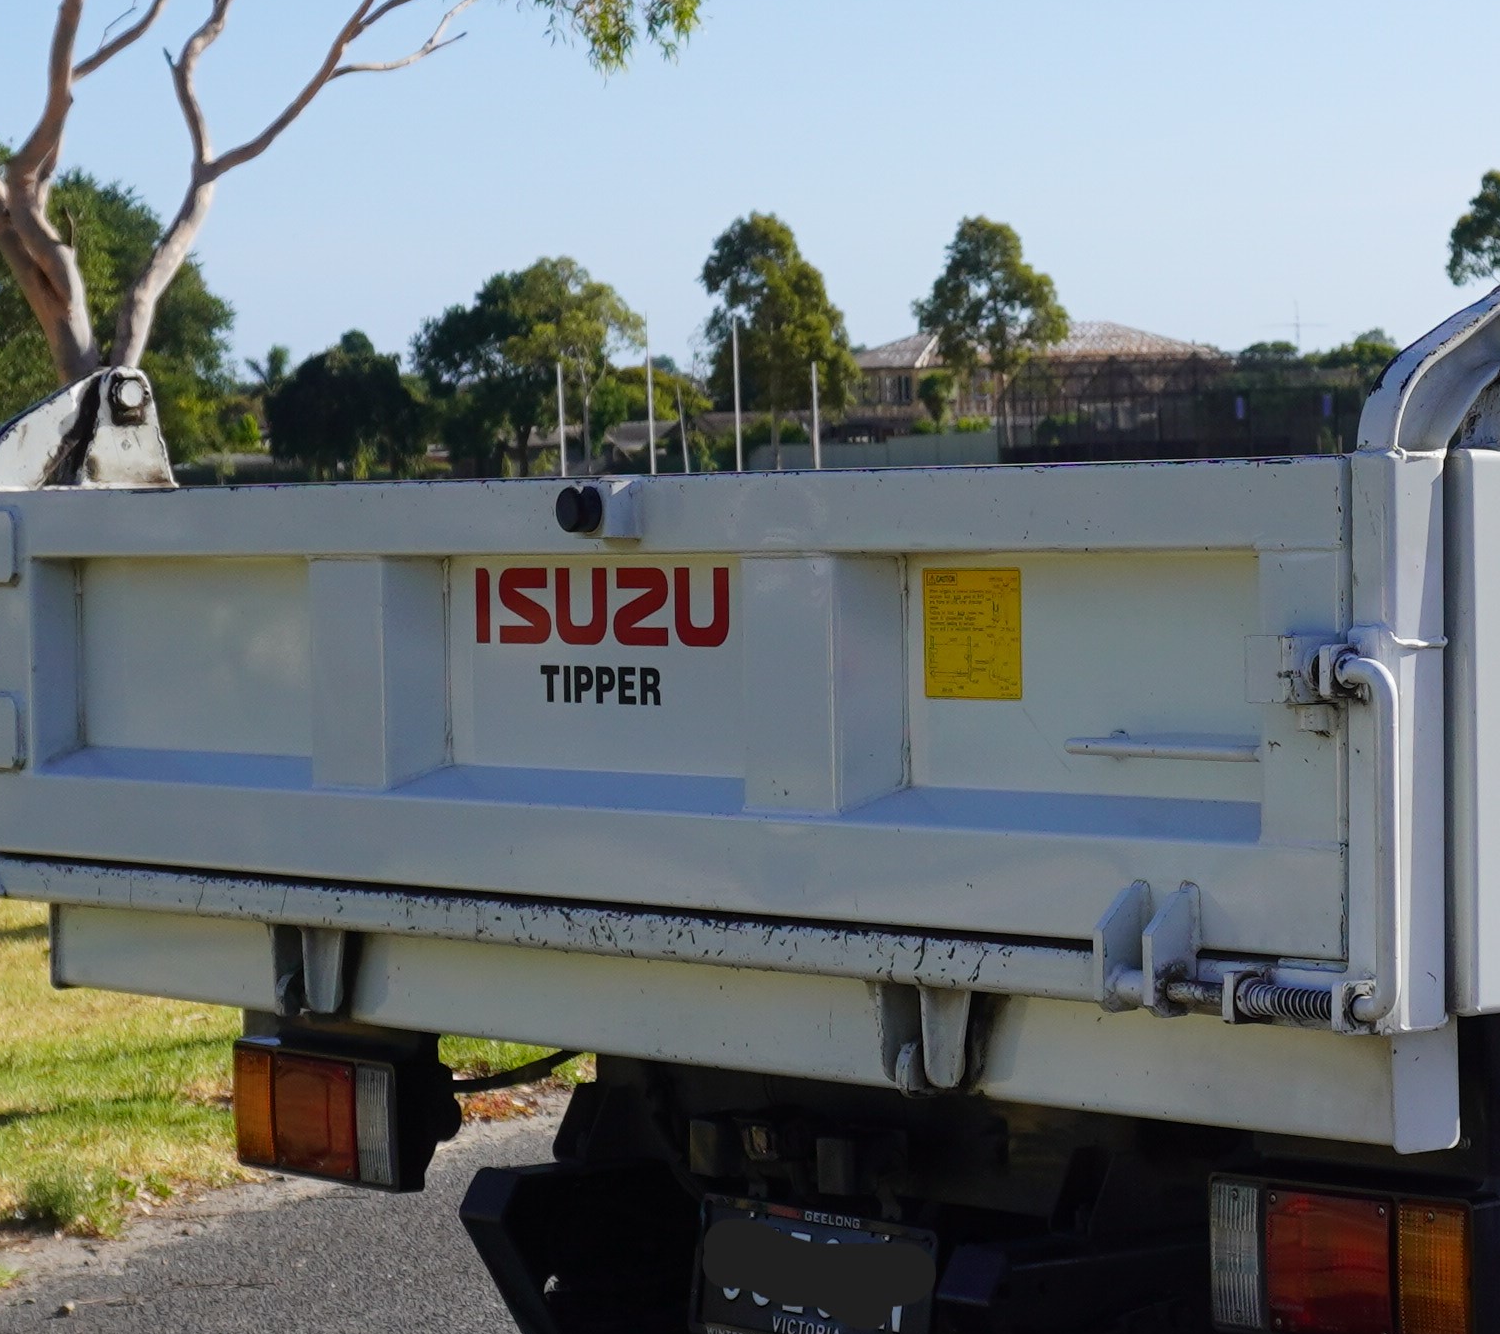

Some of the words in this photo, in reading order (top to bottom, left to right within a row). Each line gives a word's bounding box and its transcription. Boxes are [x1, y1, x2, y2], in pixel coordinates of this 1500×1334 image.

[475, 567, 730, 647] ISUZU
[540, 665, 661, 705] TIPPER
[804, 1210, 861, 1230] GEELONG
